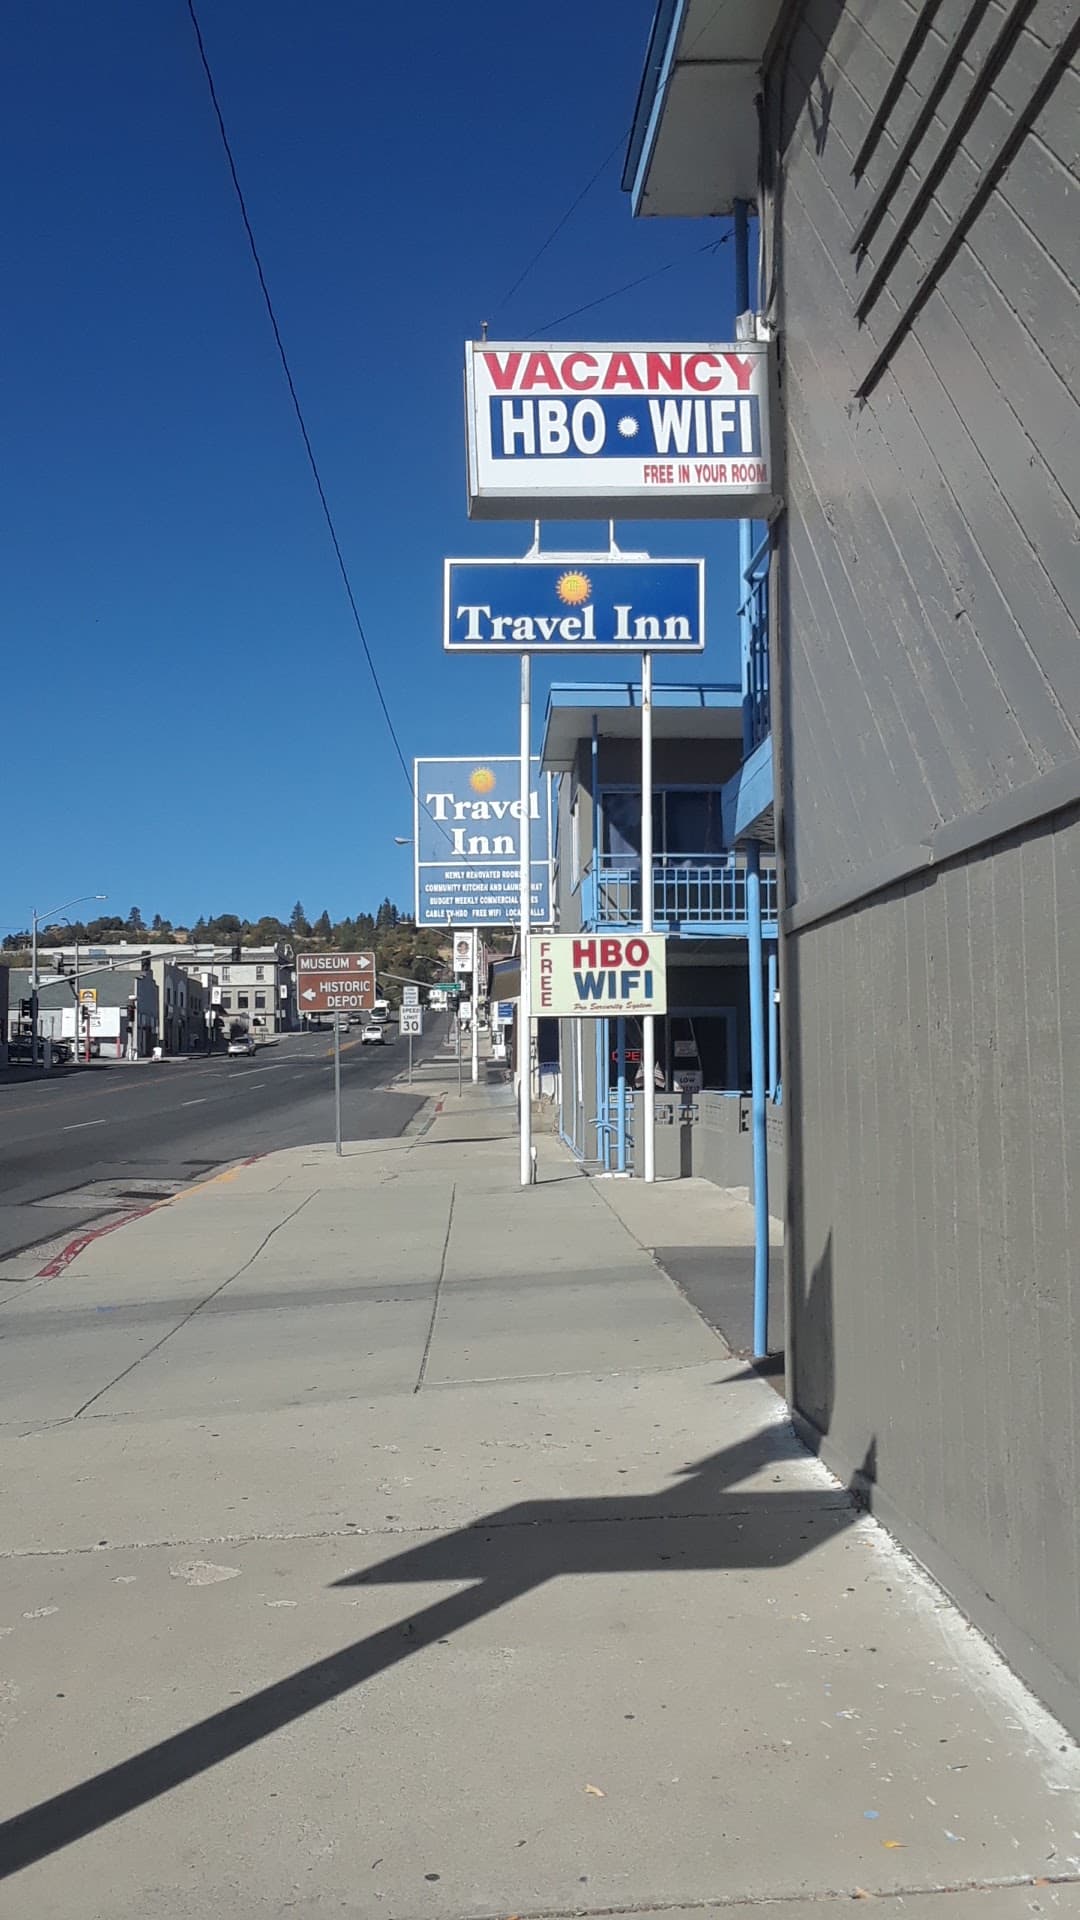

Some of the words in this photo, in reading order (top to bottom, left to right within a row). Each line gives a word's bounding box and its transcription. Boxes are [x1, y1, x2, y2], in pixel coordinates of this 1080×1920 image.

[482, 352, 760, 391] VACANCY
[501, 398, 606, 454] HBO
[648, 399, 753, 454] WIFI
[643, 464, 674, 484] FREE
[679, 464, 690, 483] IN
[695, 463, 727, 483] YOUR
[731, 463, 768, 482] ROOM
[456, 604, 596, 640] Travel
[613, 605, 692, 640] Inn
[426, 792, 541, 820] Travel
[451, 828, 516, 855] Inn
[425, 884, 461, 892] COMMUNITY
[462, 883, 488, 891] KITCHEN
[489, 883, 502, 891] AND
[480, 895, 519, 904] COMMERCIAL
[425, 909, 446, 918] CABLE
[472, 909, 488, 917] FREE
[506, 908, 521, 917] LOCA
[530, 908, 545, 916] ALLS
[300, 957, 350, 969] MUSEUM
[572, 939, 650, 968] HBO
[319, 980, 371, 993] HISTORIC
[540, 942, 553, 1007] FREE
[573, 970, 653, 1000] WIFI
[327, 995, 364, 1007] DEPOT
[403, 1021, 419, 1031] 30
